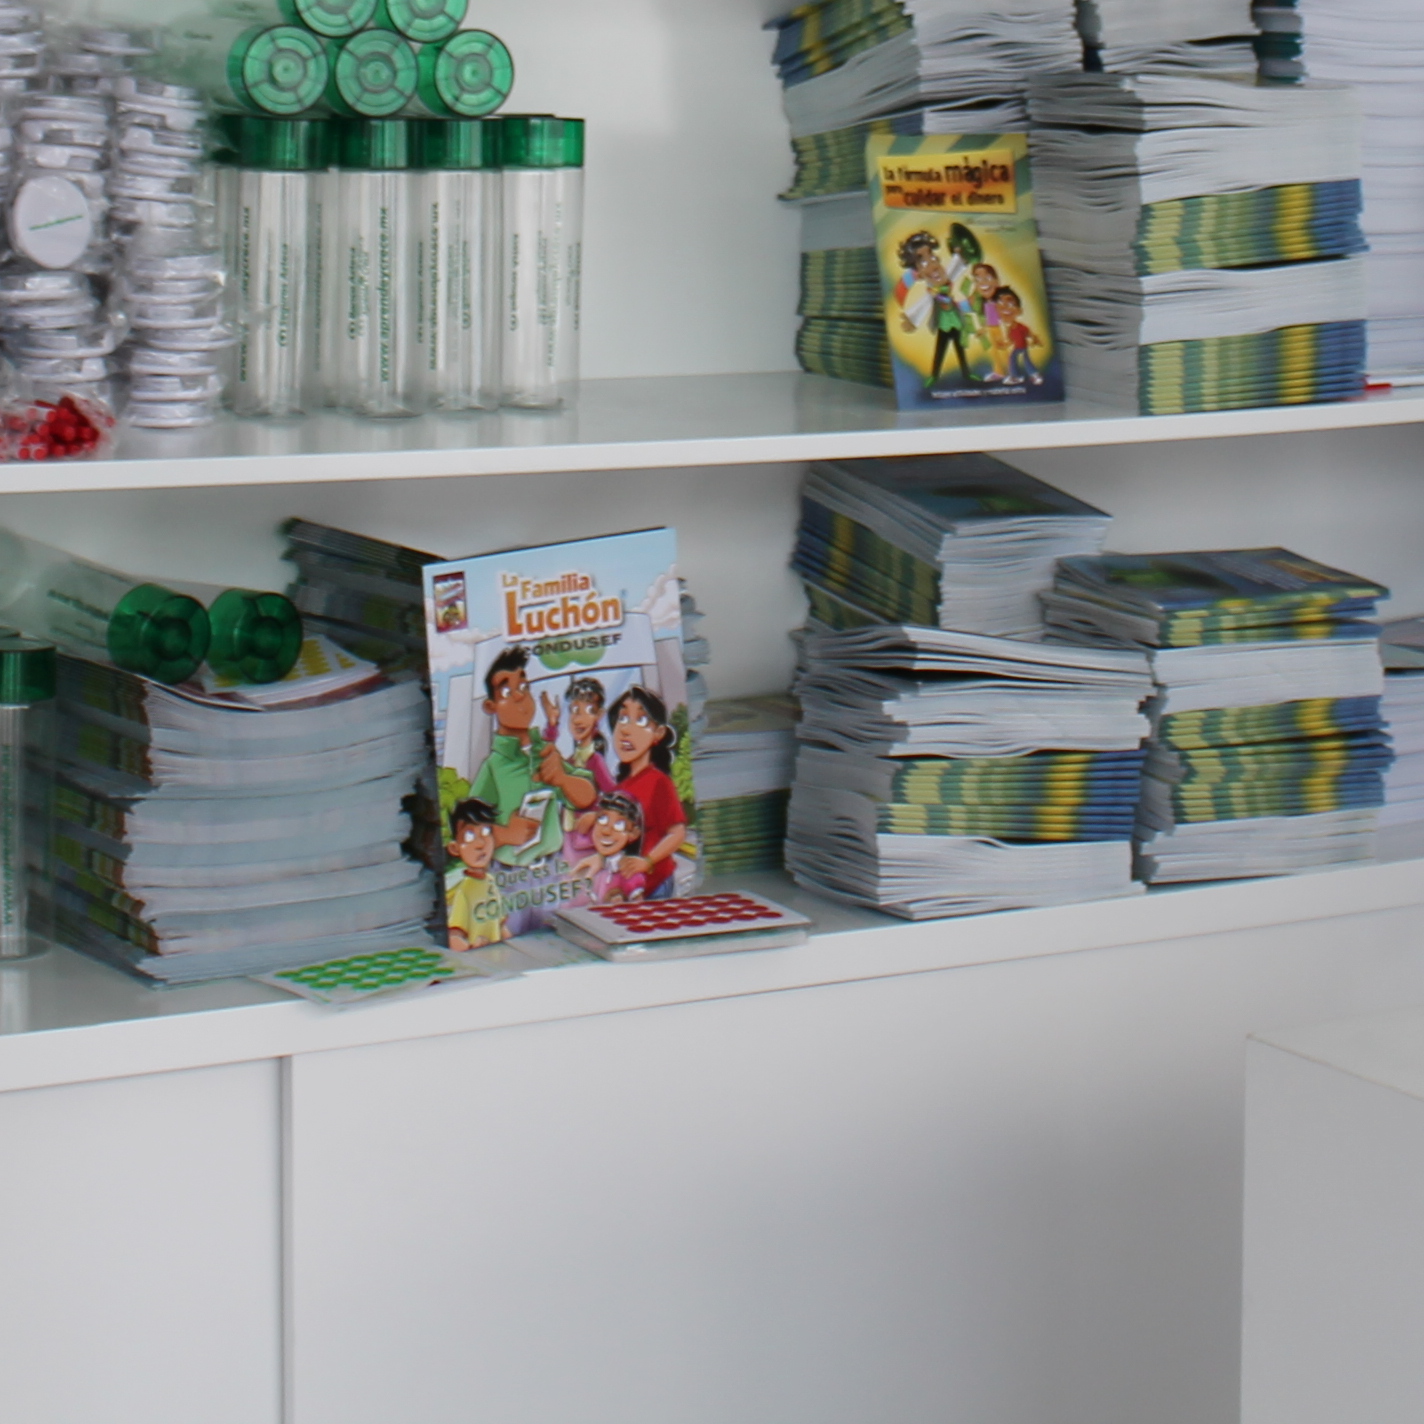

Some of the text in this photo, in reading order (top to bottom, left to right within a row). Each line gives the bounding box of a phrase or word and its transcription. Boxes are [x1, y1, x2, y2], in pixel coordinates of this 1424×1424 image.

[944, 155, 1010, 189] mágica
[502, 573, 590, 599] La Familia
[505, 591, 621, 636] Luchón
[533, 867, 550, 879] es
